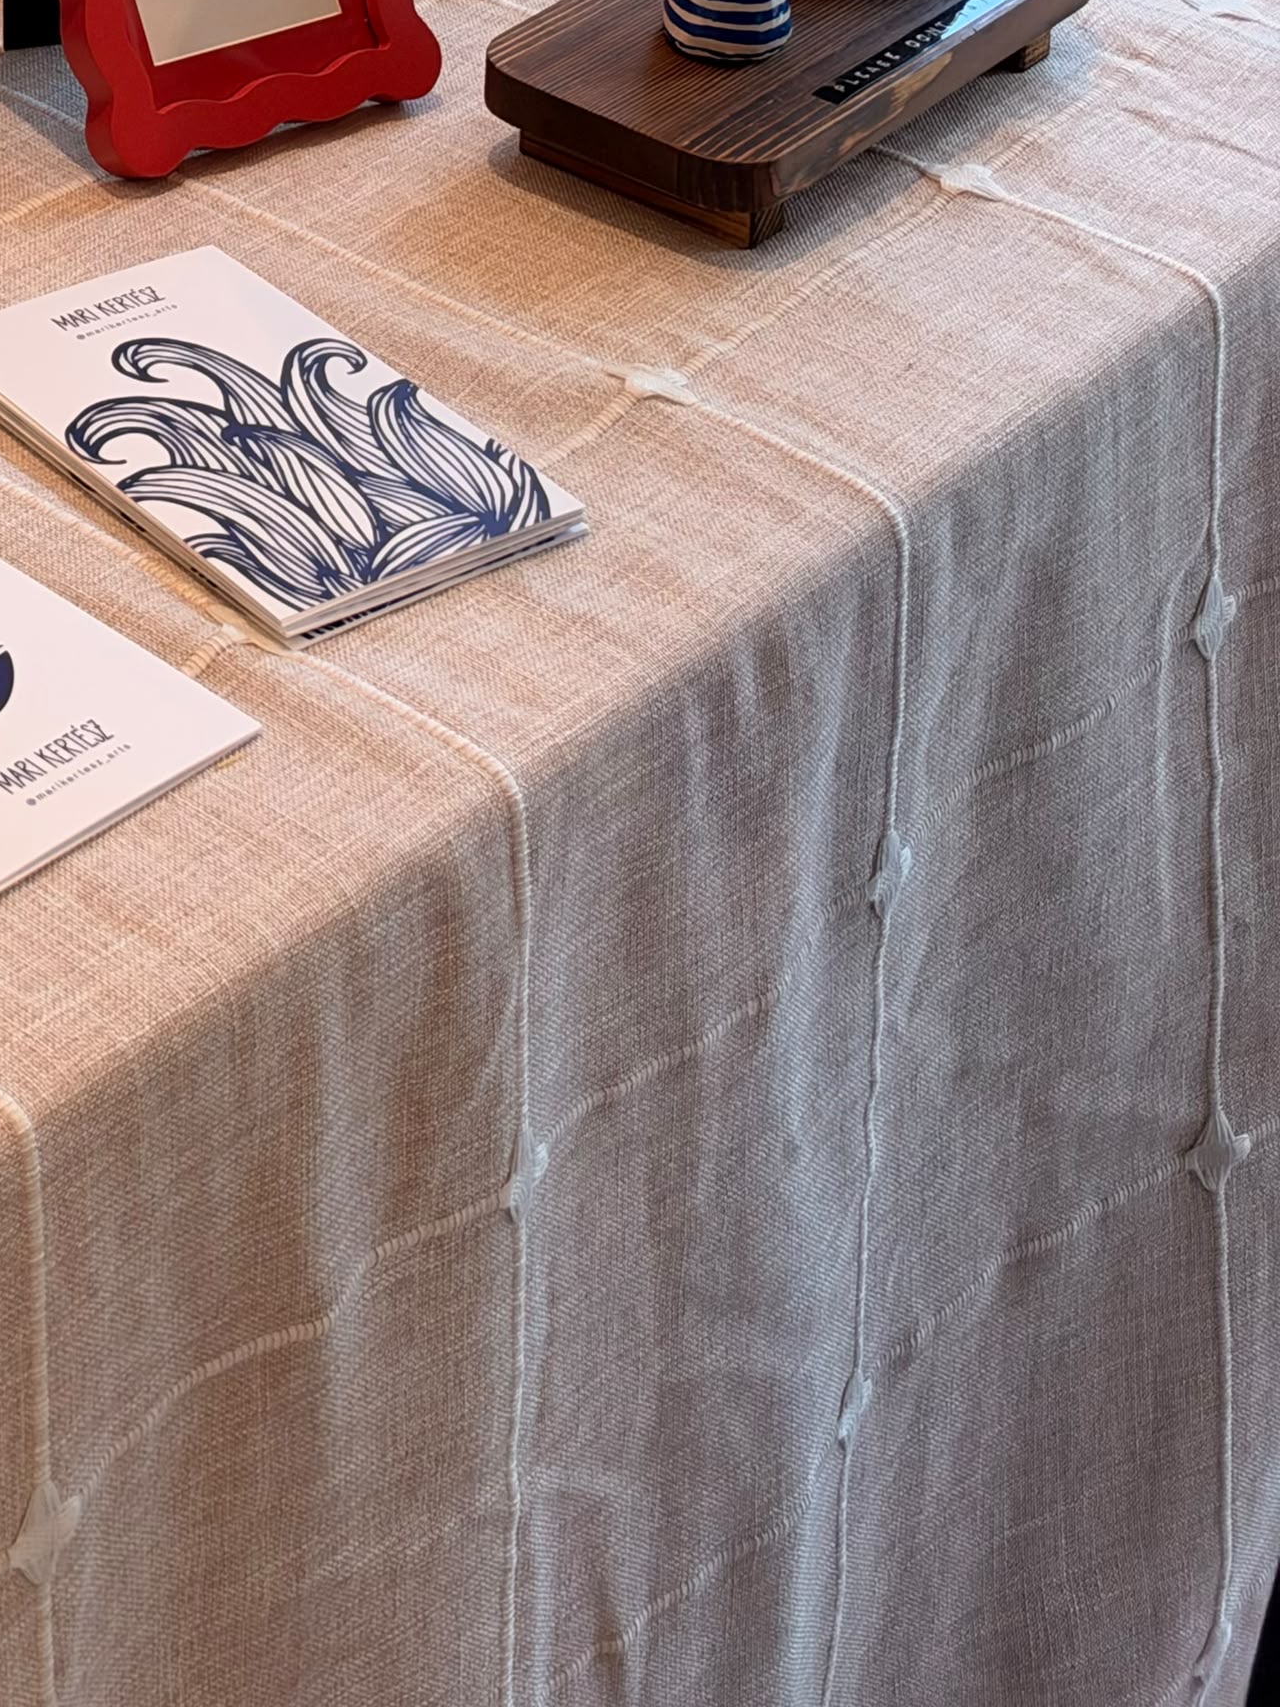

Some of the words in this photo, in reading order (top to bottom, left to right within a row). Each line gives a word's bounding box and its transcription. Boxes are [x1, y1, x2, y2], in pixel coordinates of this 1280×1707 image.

[834, 51, 901, 93] PLEASE
[51, 307, 101, 331] MARI
[93, 286, 166, 317] KERTÉSZ
[34, 719, 115, 769] KERTÉSZ
